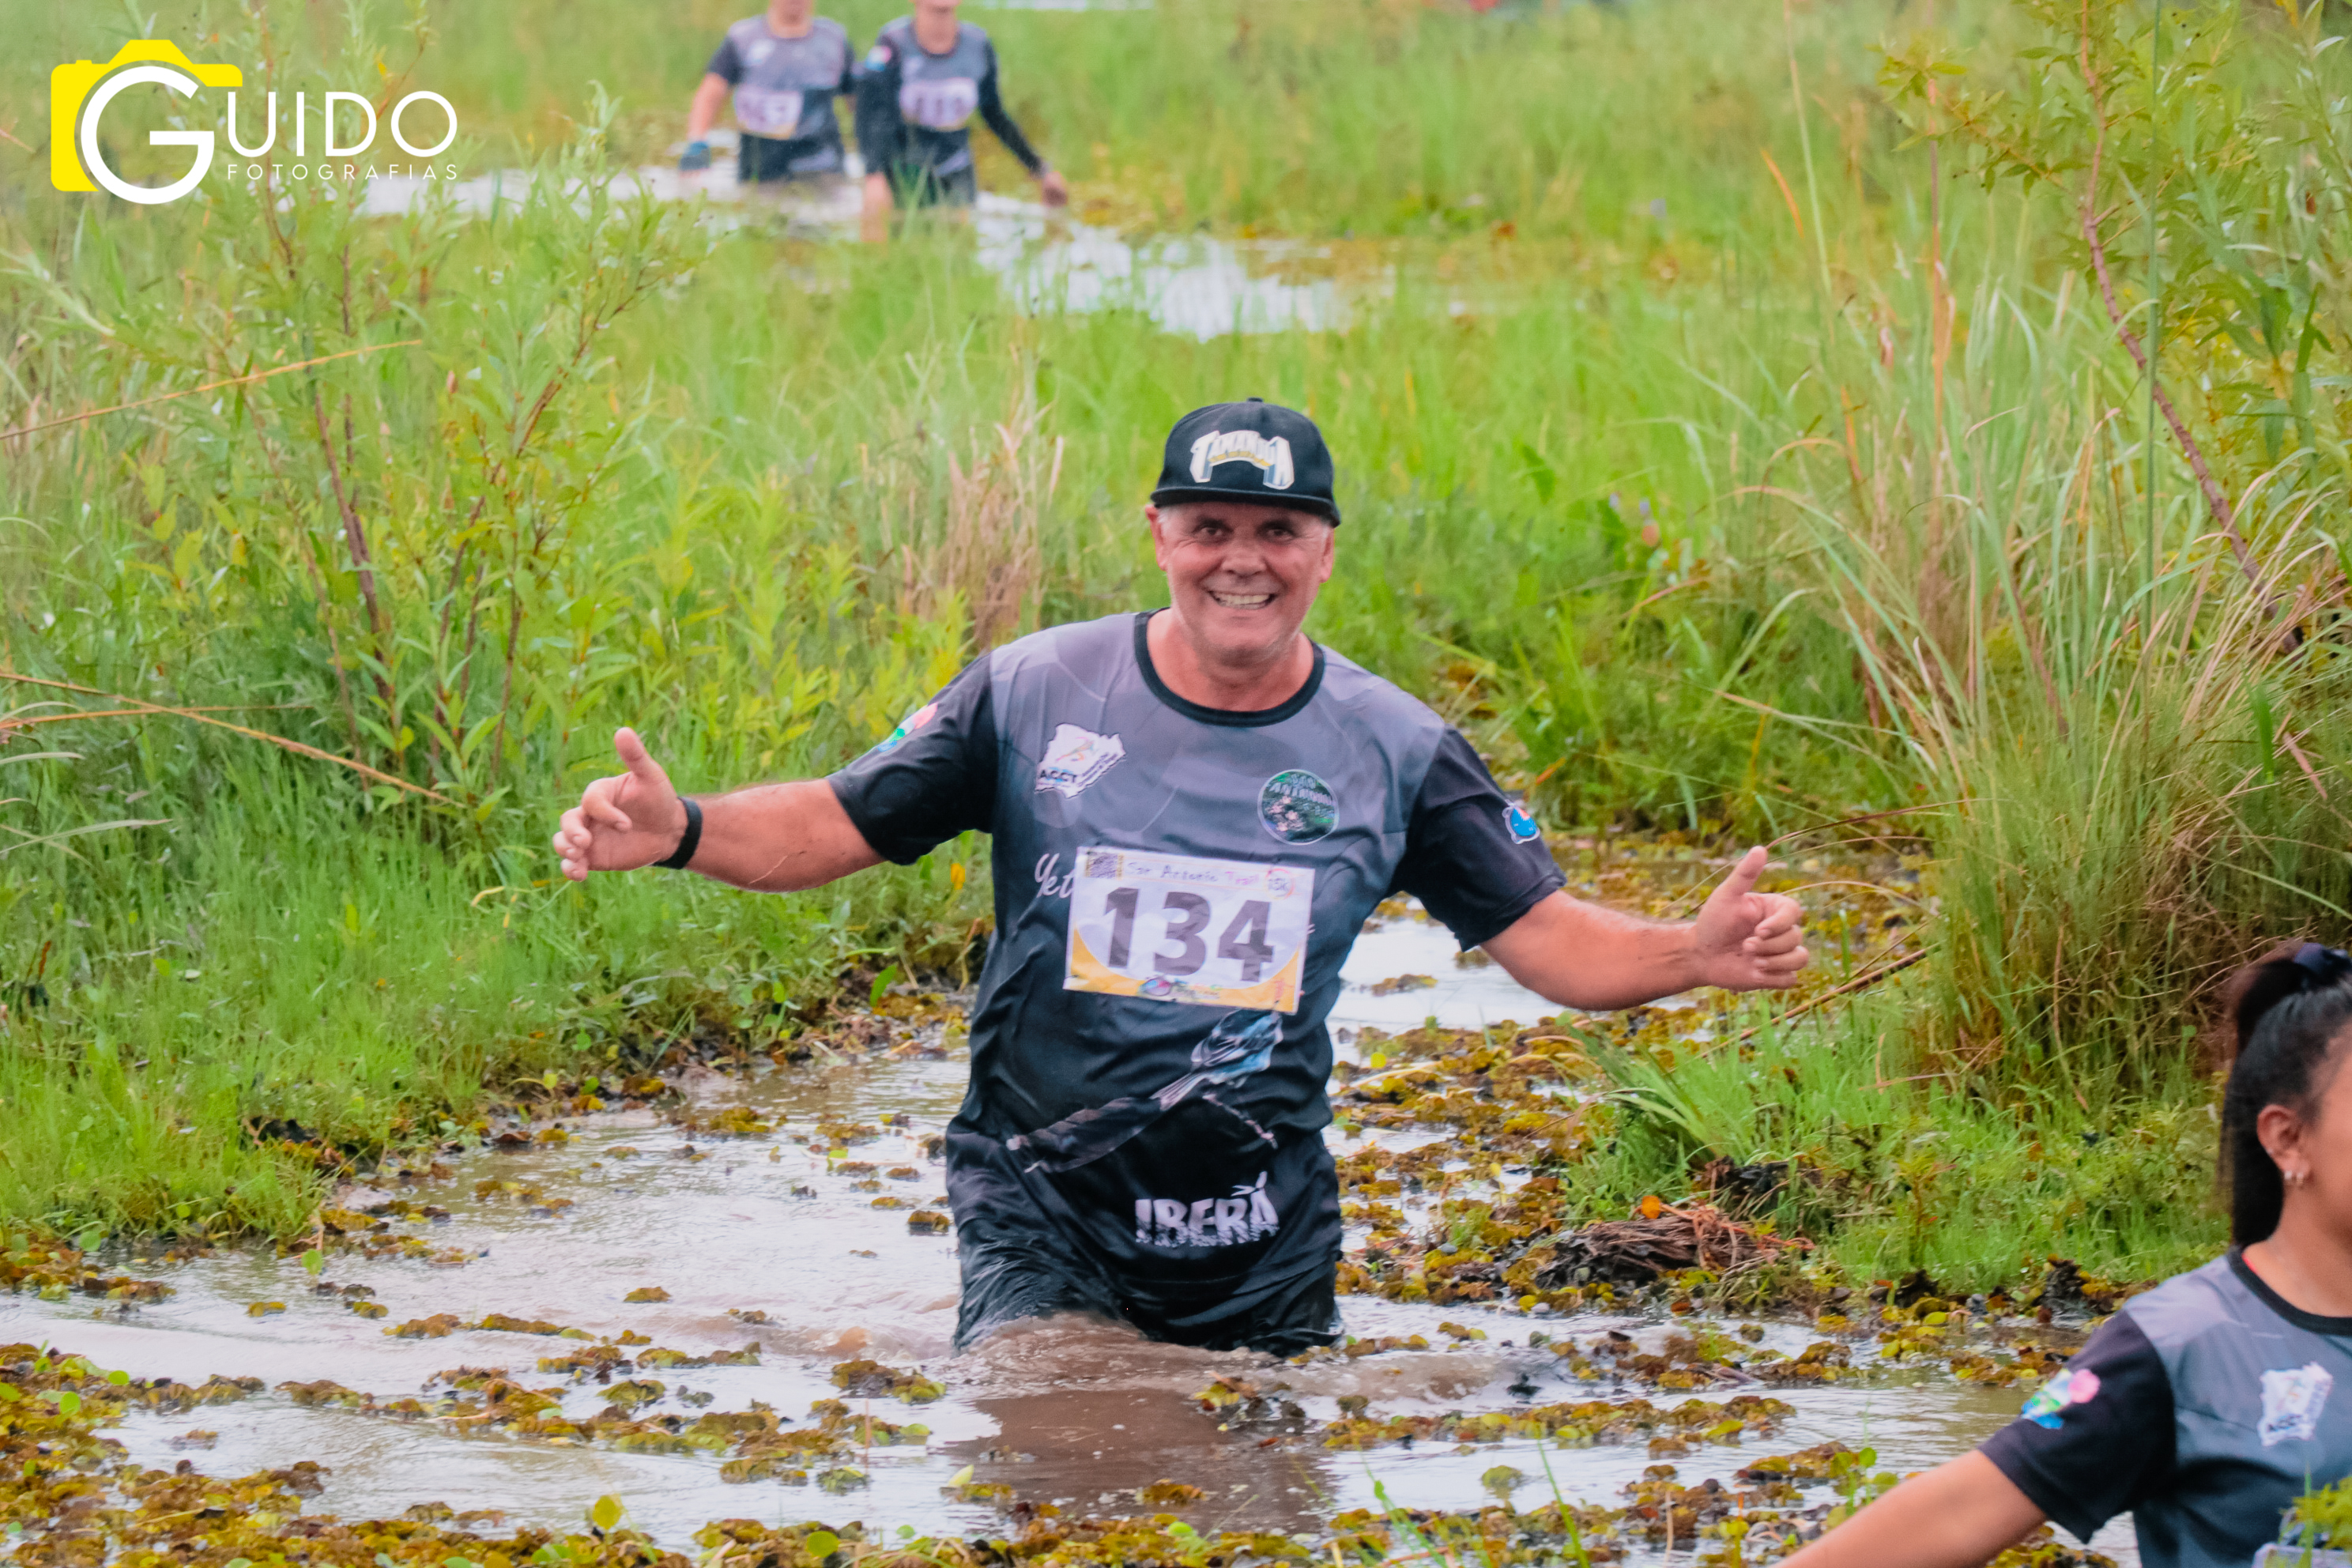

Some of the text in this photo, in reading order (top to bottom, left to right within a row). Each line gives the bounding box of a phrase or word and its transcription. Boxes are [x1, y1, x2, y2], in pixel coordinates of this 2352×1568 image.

[1039, 768, 1078, 784] ACCT
[1035, 853, 1074, 898] Yet
[1105, 887, 1277, 982] 134
